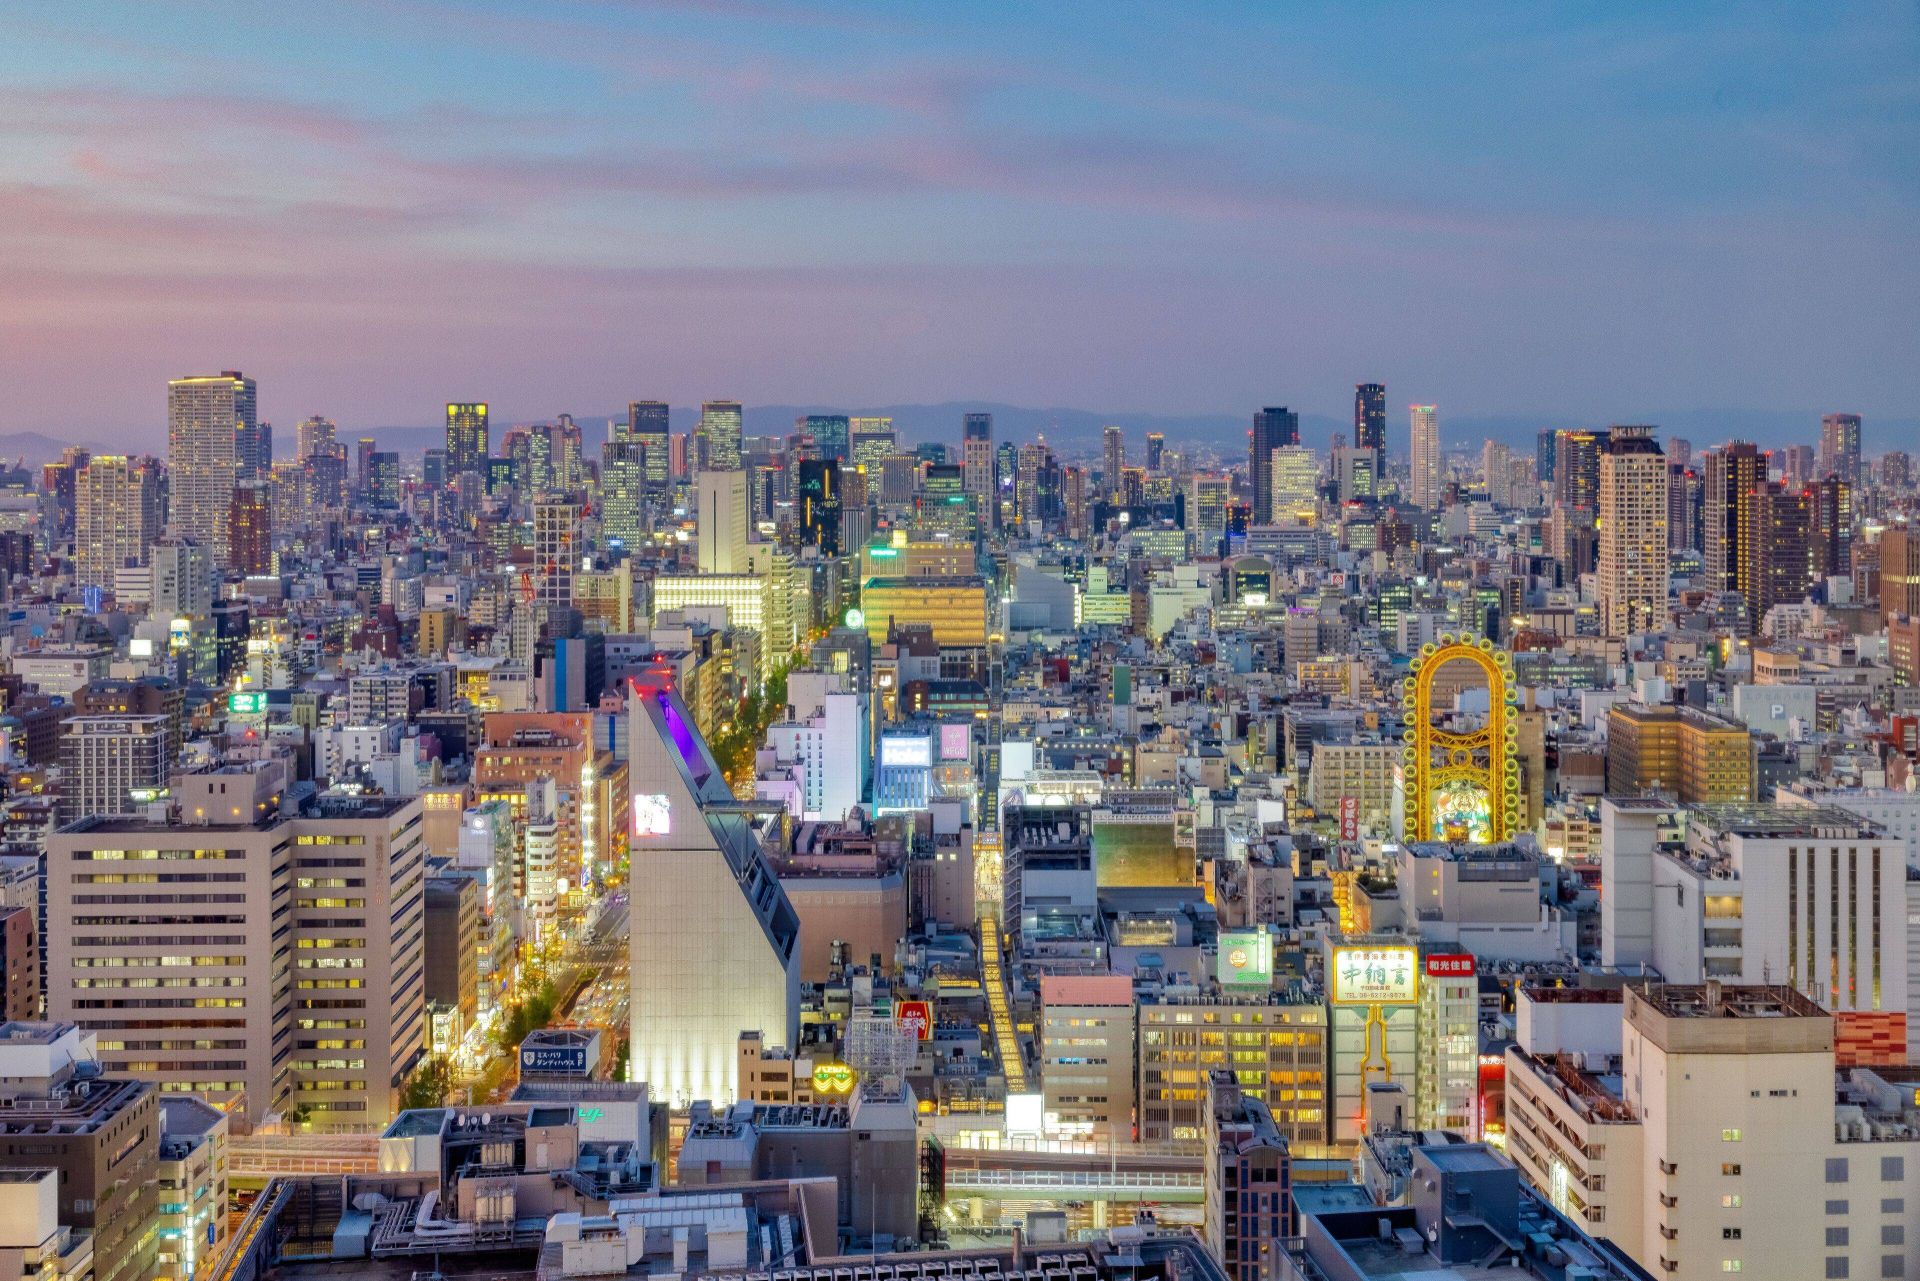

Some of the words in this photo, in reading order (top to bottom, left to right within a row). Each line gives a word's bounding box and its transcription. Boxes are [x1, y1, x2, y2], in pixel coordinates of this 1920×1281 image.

[1772, 704, 1784, 718] P
[1342, 962, 1409, 985] 中納言
